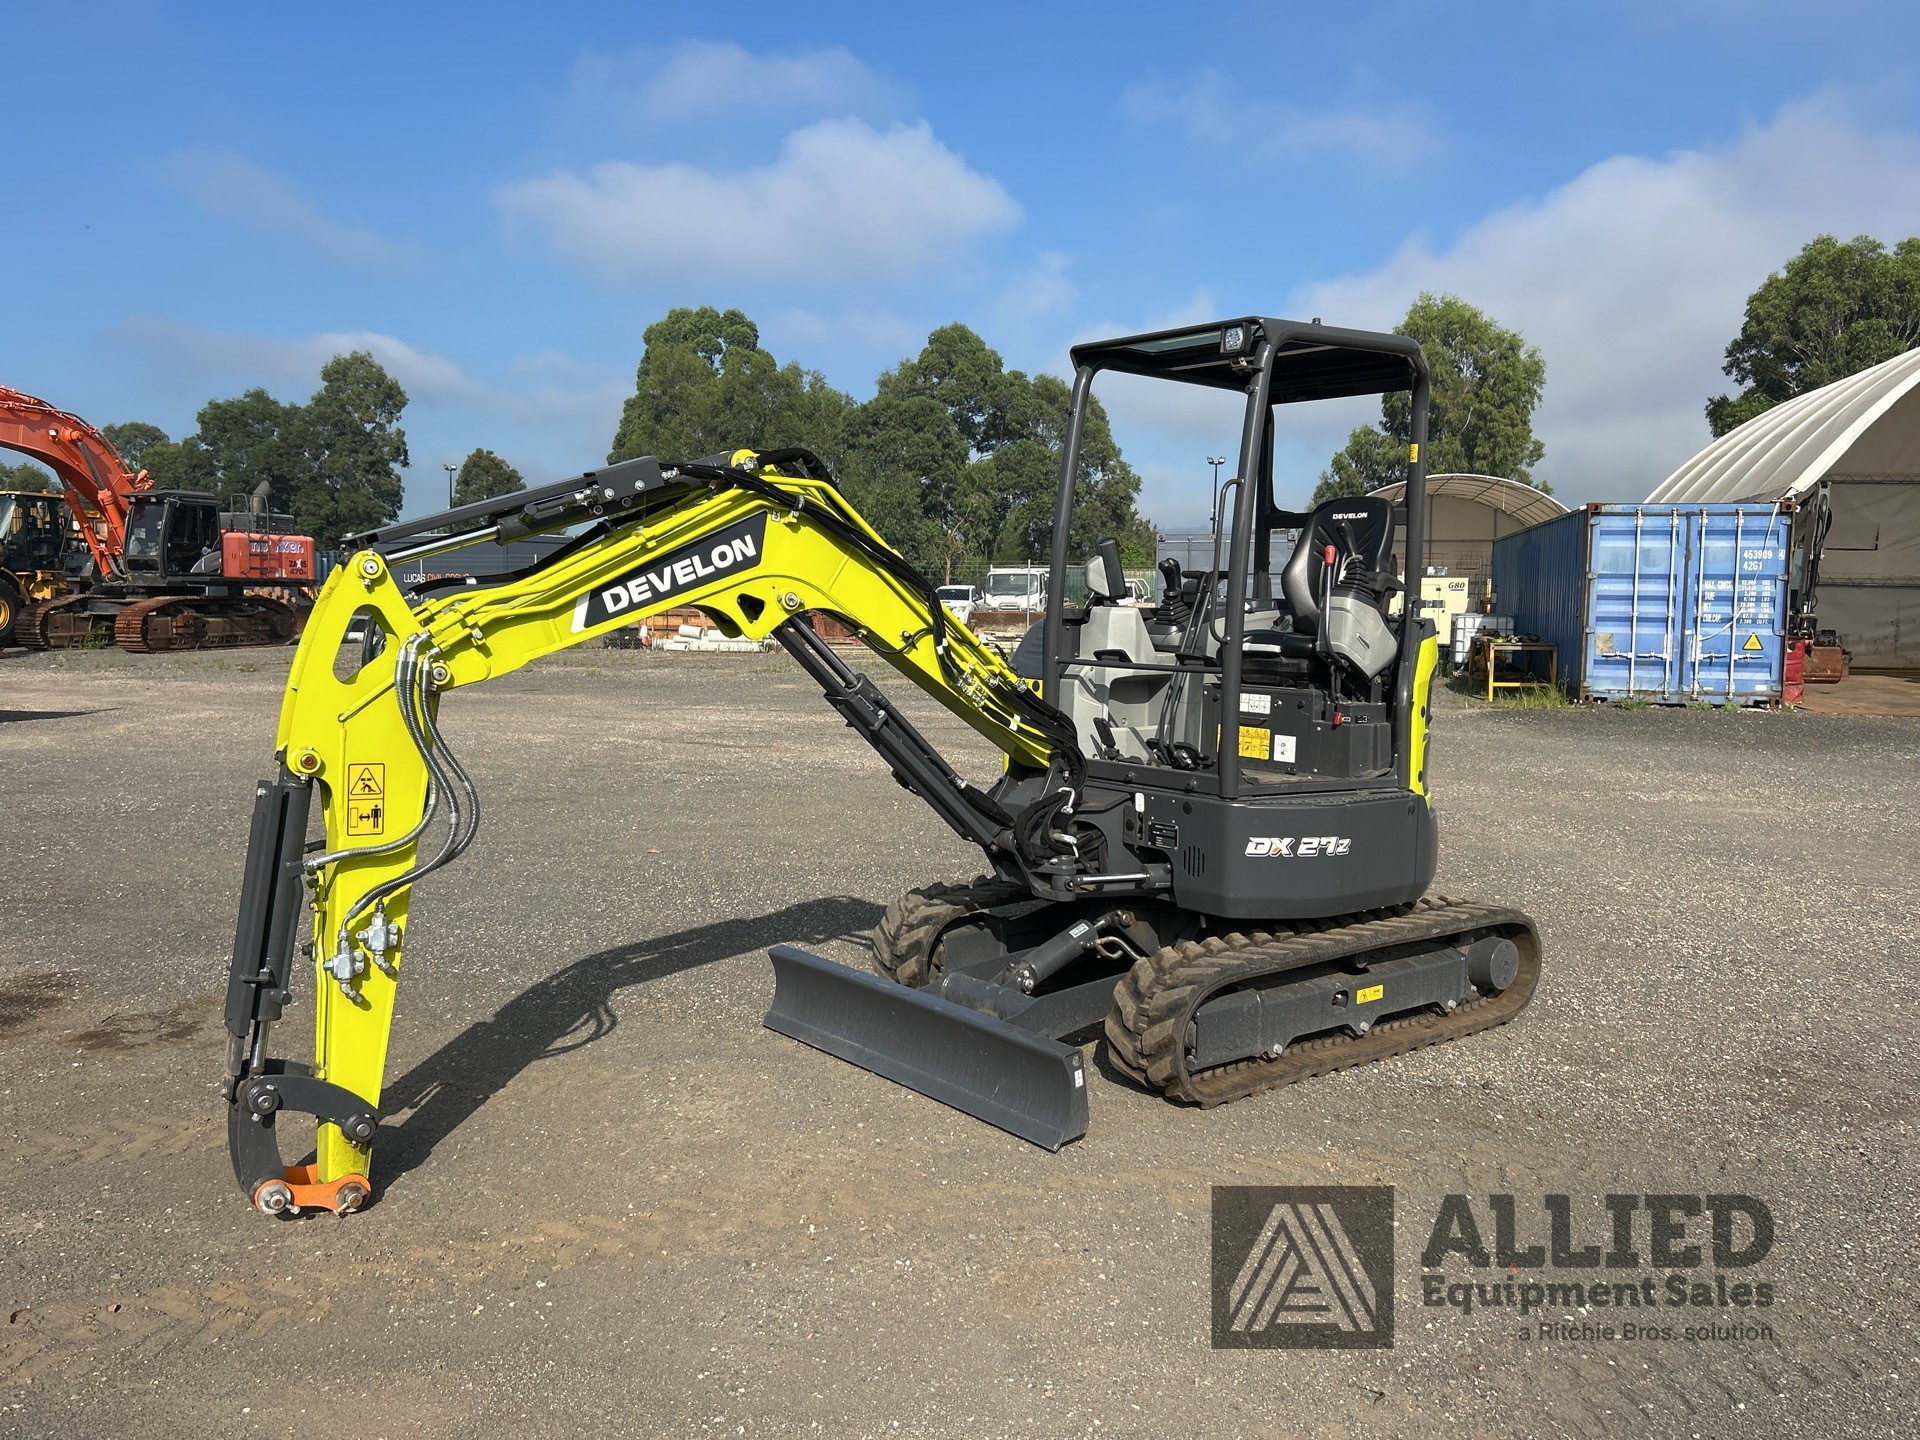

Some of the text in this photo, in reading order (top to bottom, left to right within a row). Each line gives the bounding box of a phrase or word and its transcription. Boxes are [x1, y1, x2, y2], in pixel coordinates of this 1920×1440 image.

[1332, 511, 1368, 520] DEVELON
[289, 559, 307, 569] ZAXIS
[1743, 561, 1763, 571] 42G1
[403, 573, 426, 583] LUCAS
[601, 534, 757, 614] DEVELON
[1448, 581, 1465, 589] G80
[1704, 591, 1715, 601] TARE
[1244, 836, 1296, 858] DX
